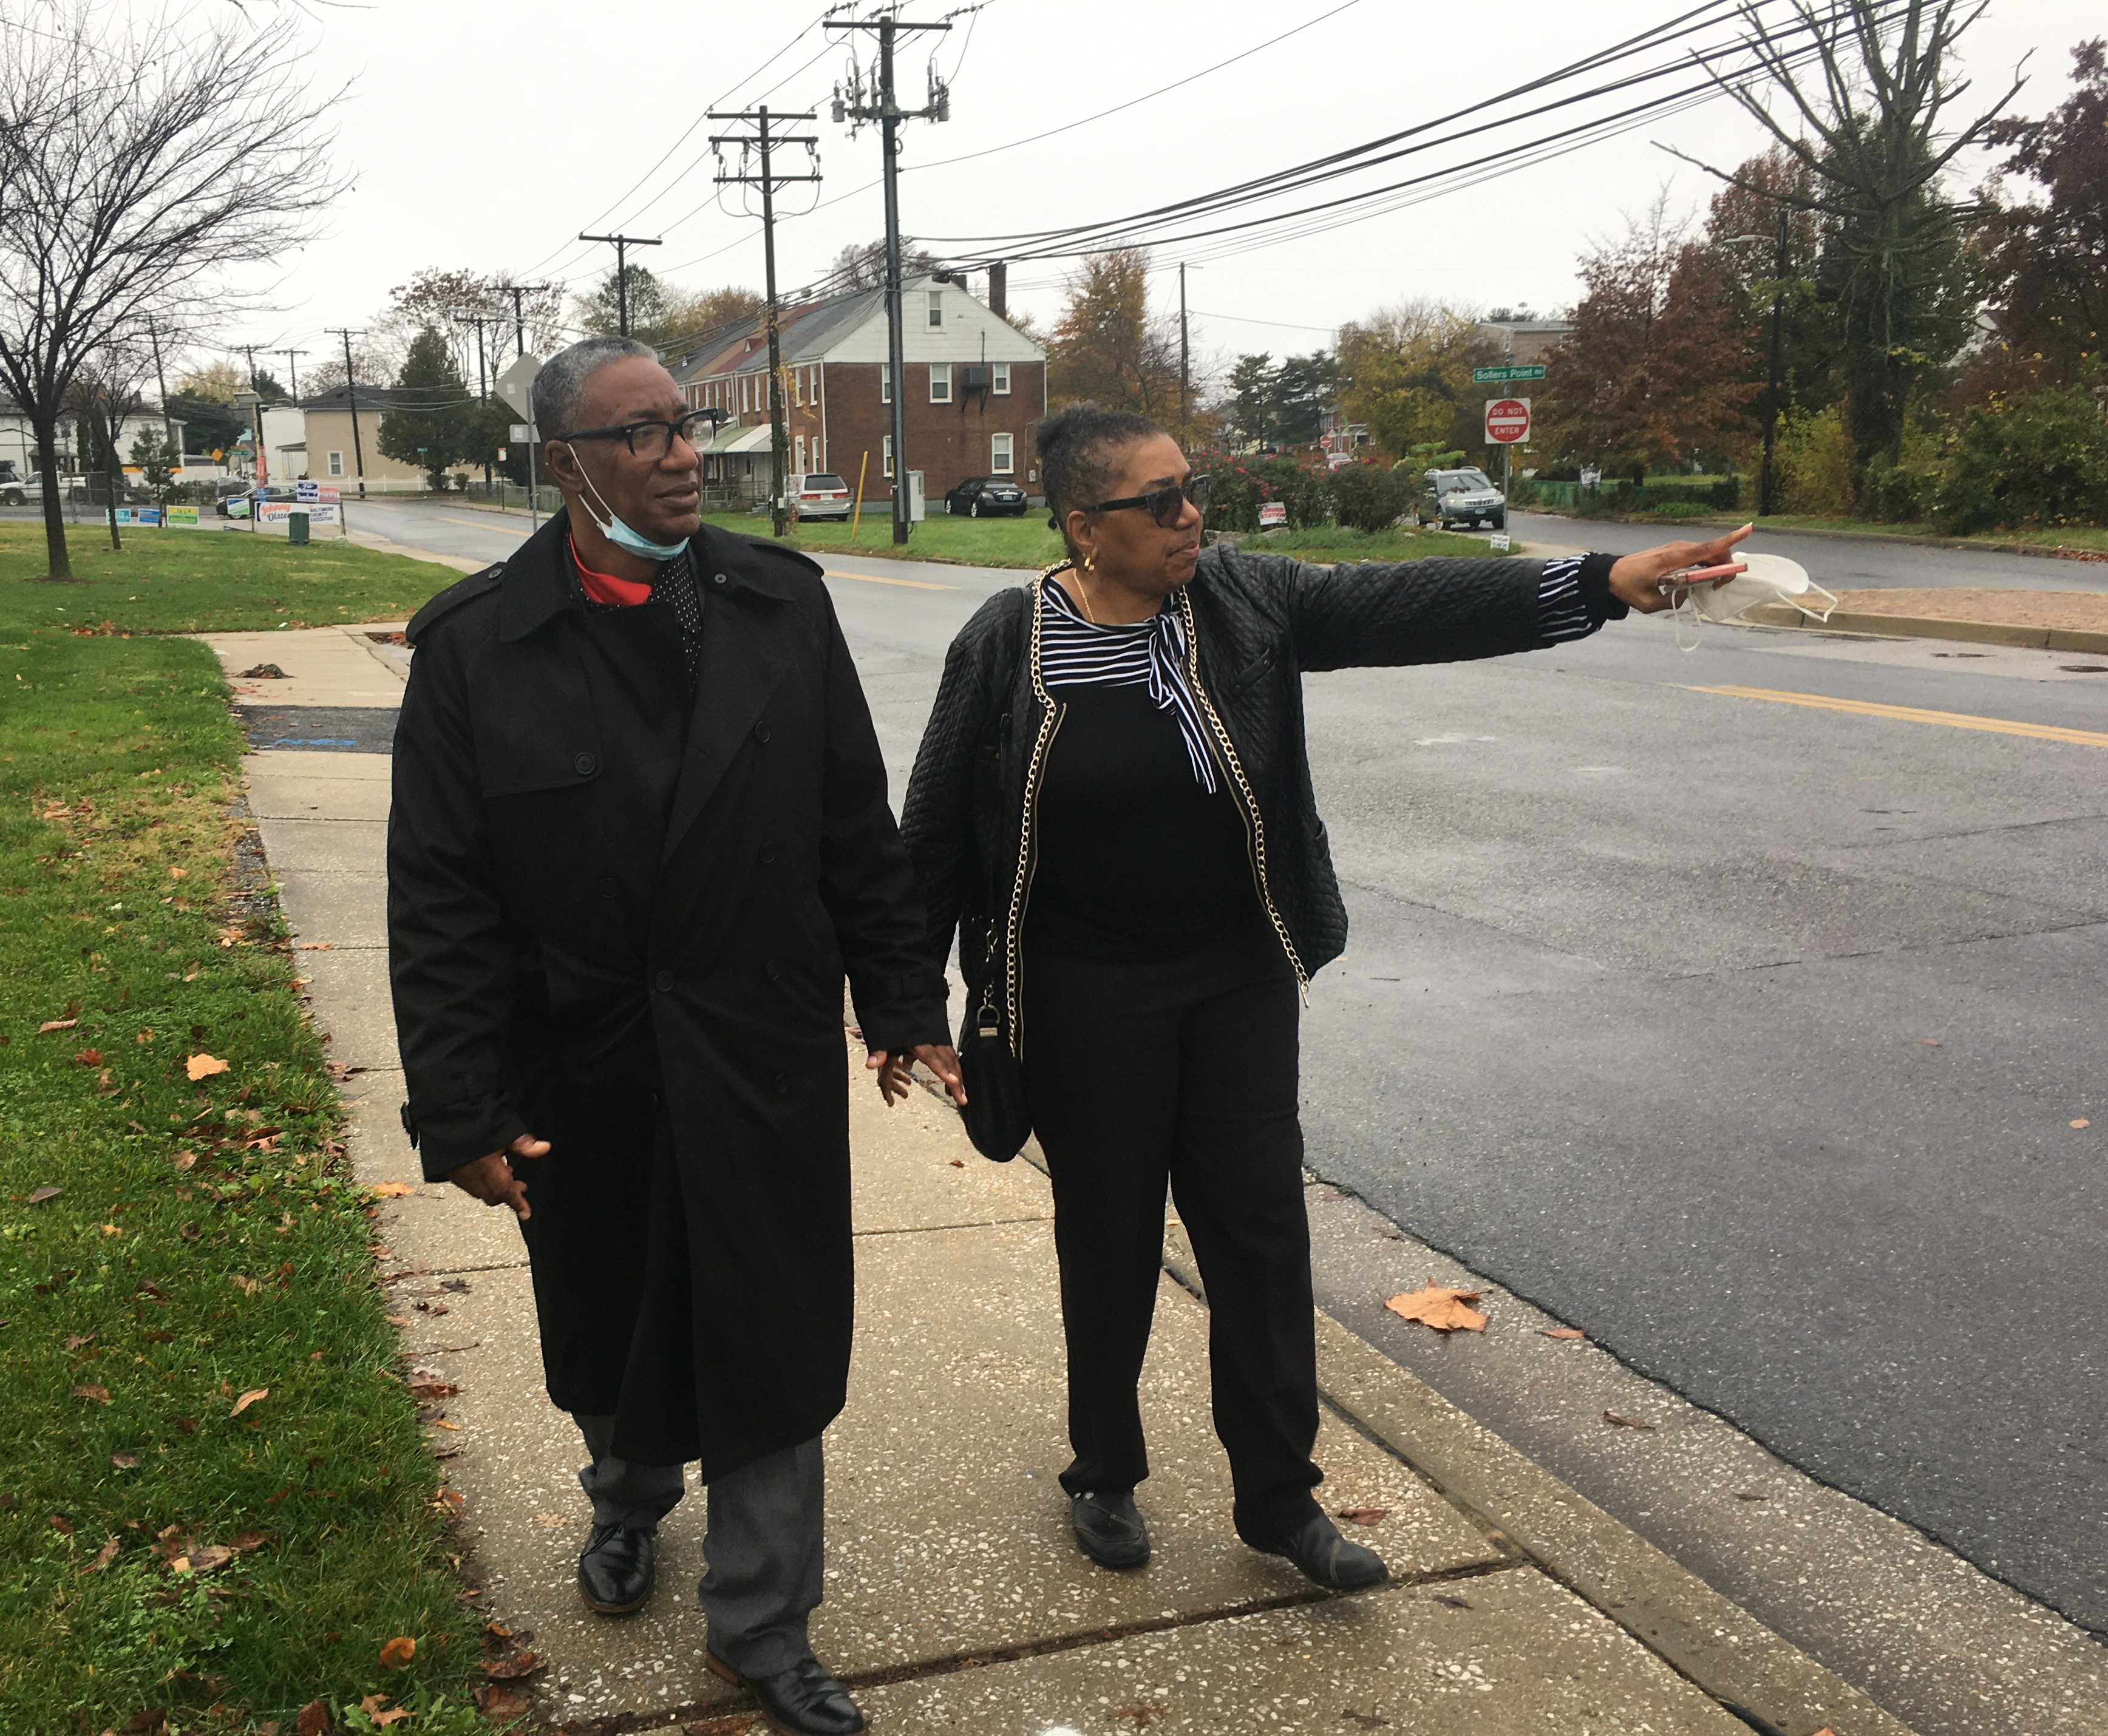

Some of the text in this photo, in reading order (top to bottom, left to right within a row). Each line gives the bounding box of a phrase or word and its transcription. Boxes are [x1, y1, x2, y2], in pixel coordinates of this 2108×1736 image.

[1477, 370, 1508, 380] Sollers
[1510, 368, 1532, 378] Point
[1508, 407, 1523, 415] NOT
[1495, 426, 1520, 435] ENTER
[262, 504, 291, 517] Johnny
